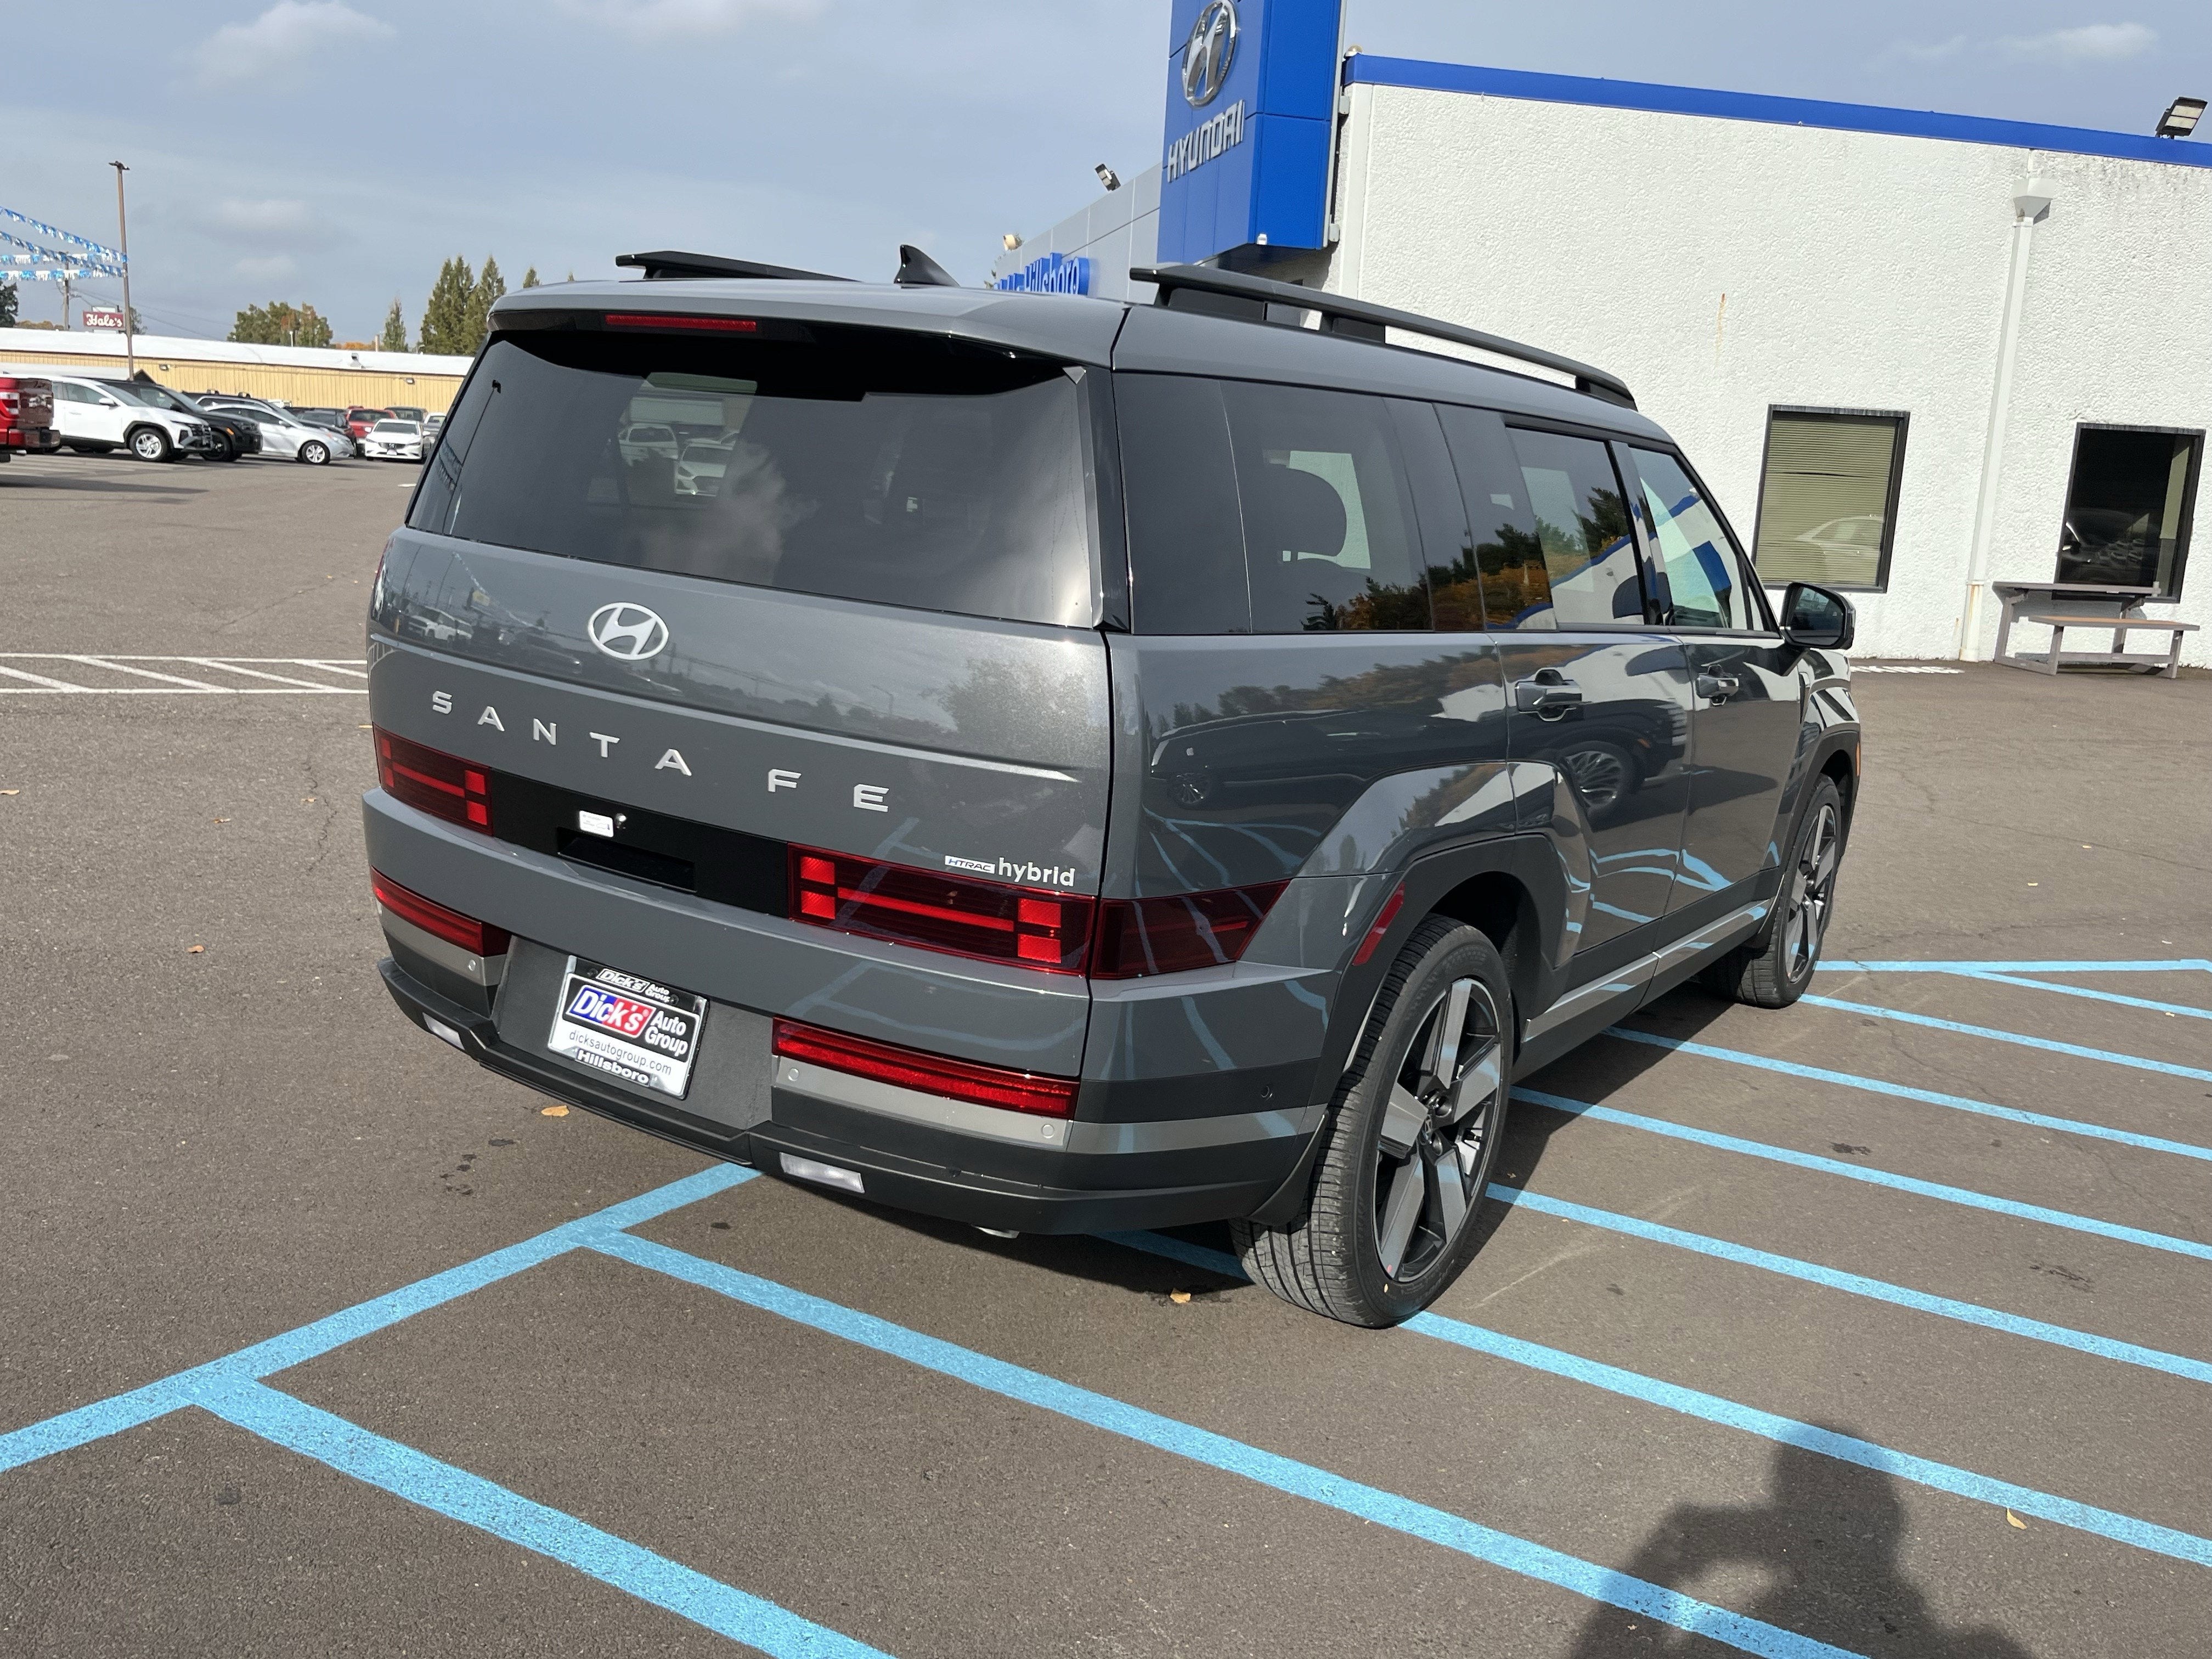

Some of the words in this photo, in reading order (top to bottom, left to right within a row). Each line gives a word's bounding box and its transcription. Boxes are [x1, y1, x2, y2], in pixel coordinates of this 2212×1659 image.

[1167, 99, 1245, 183] HYUNDAI
[86, 313, 122, 328] Hale's
[432, 691, 692, 776] SANTA
[768, 769, 889, 812] FE
[948, 858, 991, 872] HTRAC
[998, 857, 1075, 887] hybrid
[600, 970, 645, 991] Dick's
[648, 984, 670, 996] Auto
[573, 990, 645, 1032] Dick's
[651, 1011, 686, 1036] Auto
[569, 1030, 672, 1075] dicksautogroup.com
[645, 1026, 688, 1057] Group
[577, 1048, 650, 1085] Hillsboro
